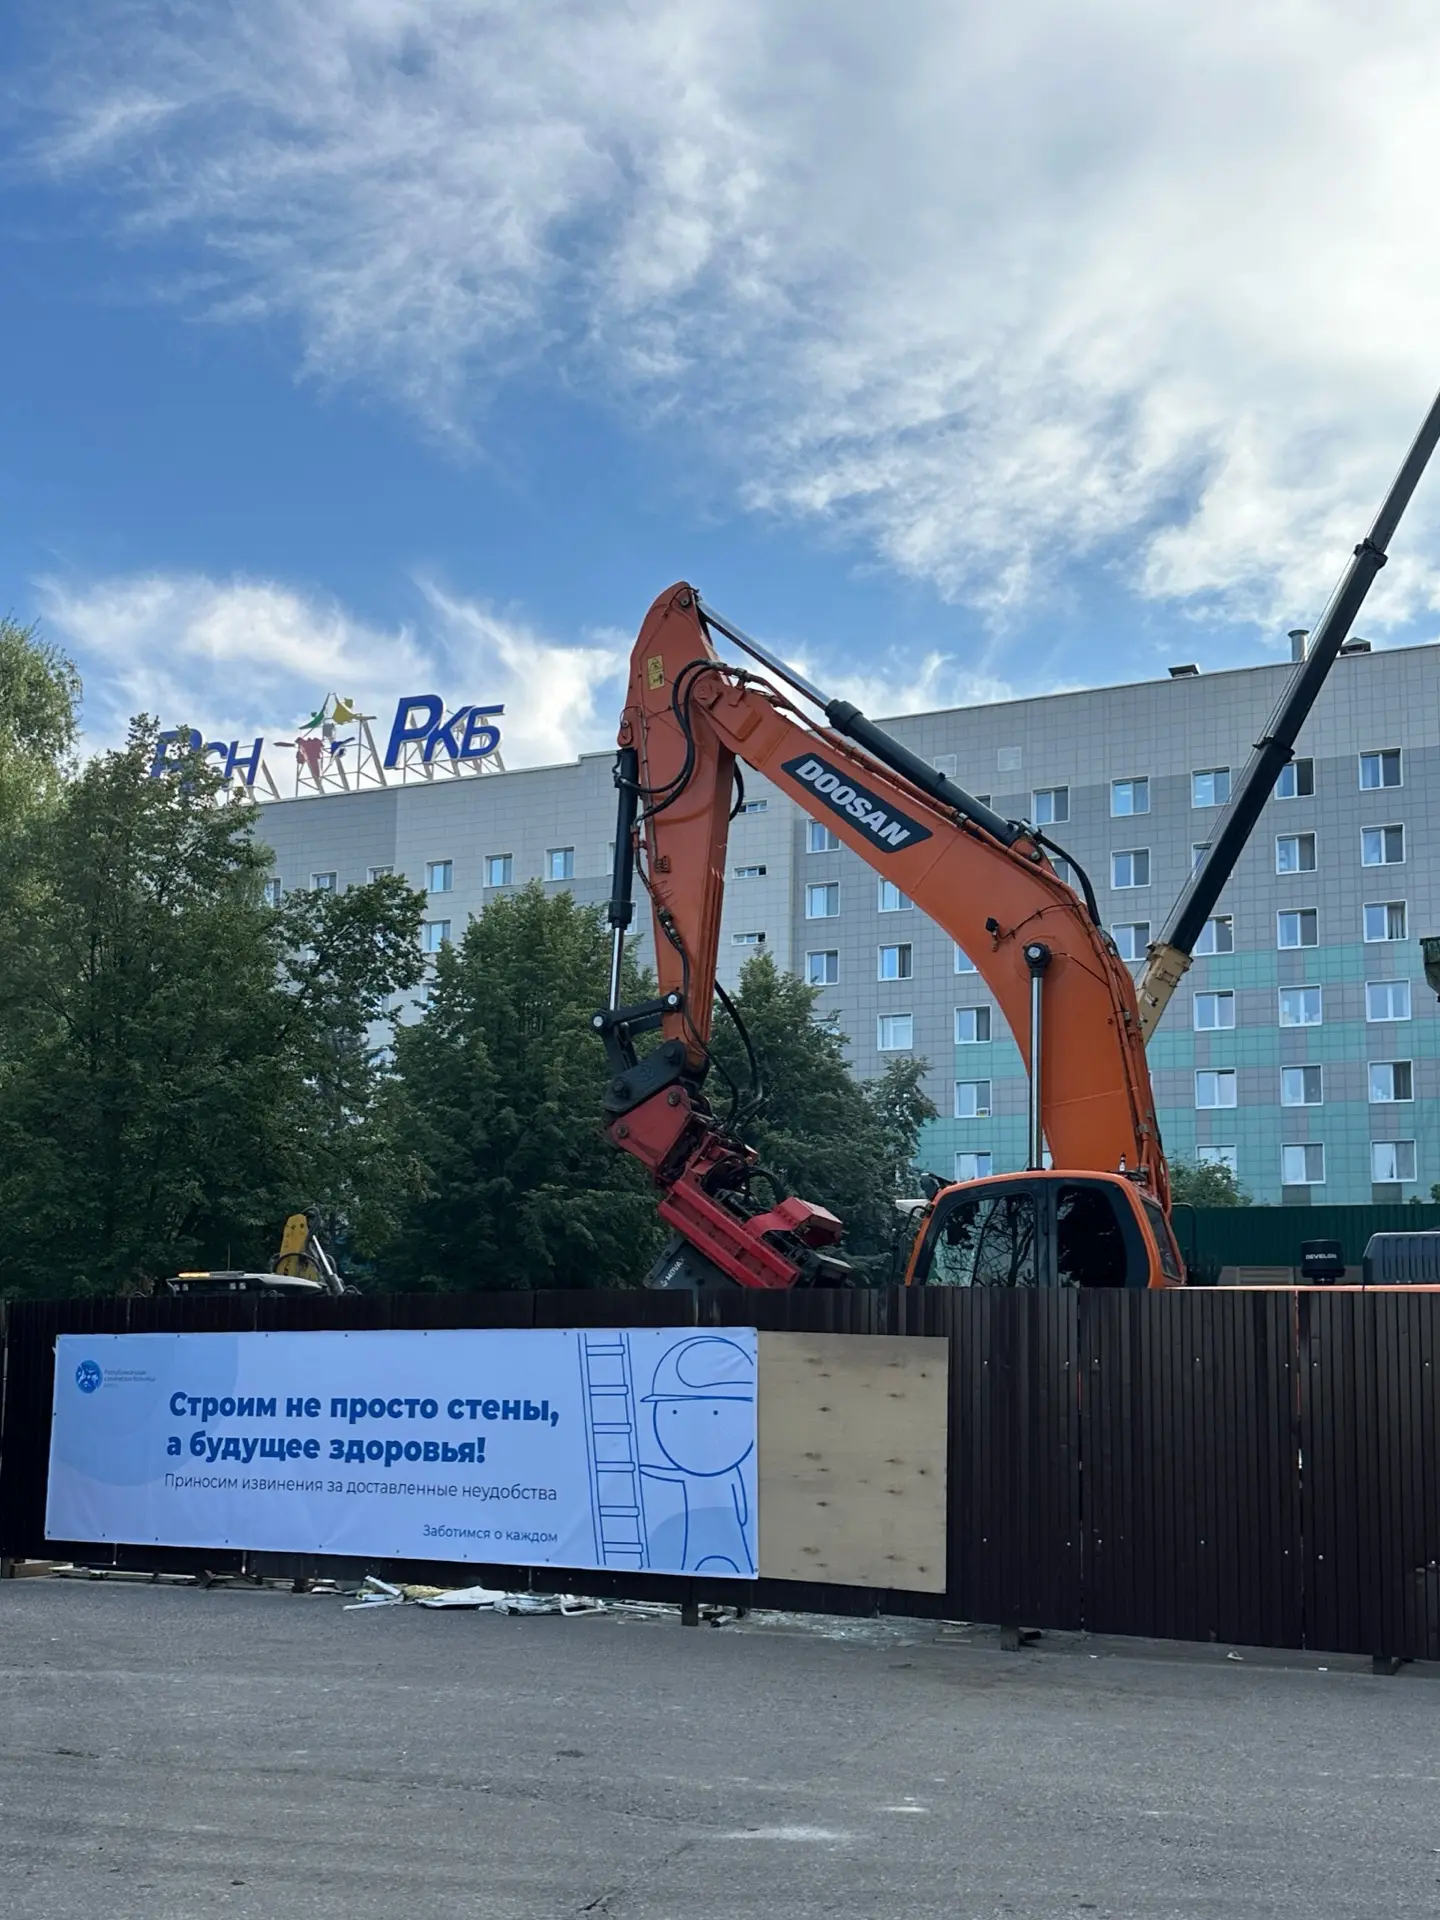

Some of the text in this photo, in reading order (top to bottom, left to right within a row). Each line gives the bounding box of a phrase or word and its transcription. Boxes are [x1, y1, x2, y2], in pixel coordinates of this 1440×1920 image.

[383, 693, 505, 770] РКБ
[795, 759, 911, 847] DOOSAN
[169, 1391, 559, 1428] Строим не просто стены,
[166, 1430, 486, 1468] а будущее здоровья!
[164, 1473, 557, 1502] Приносим извинения за доставленные неудобства
[423, 1524, 558, 1543] Заботимся о каждом
